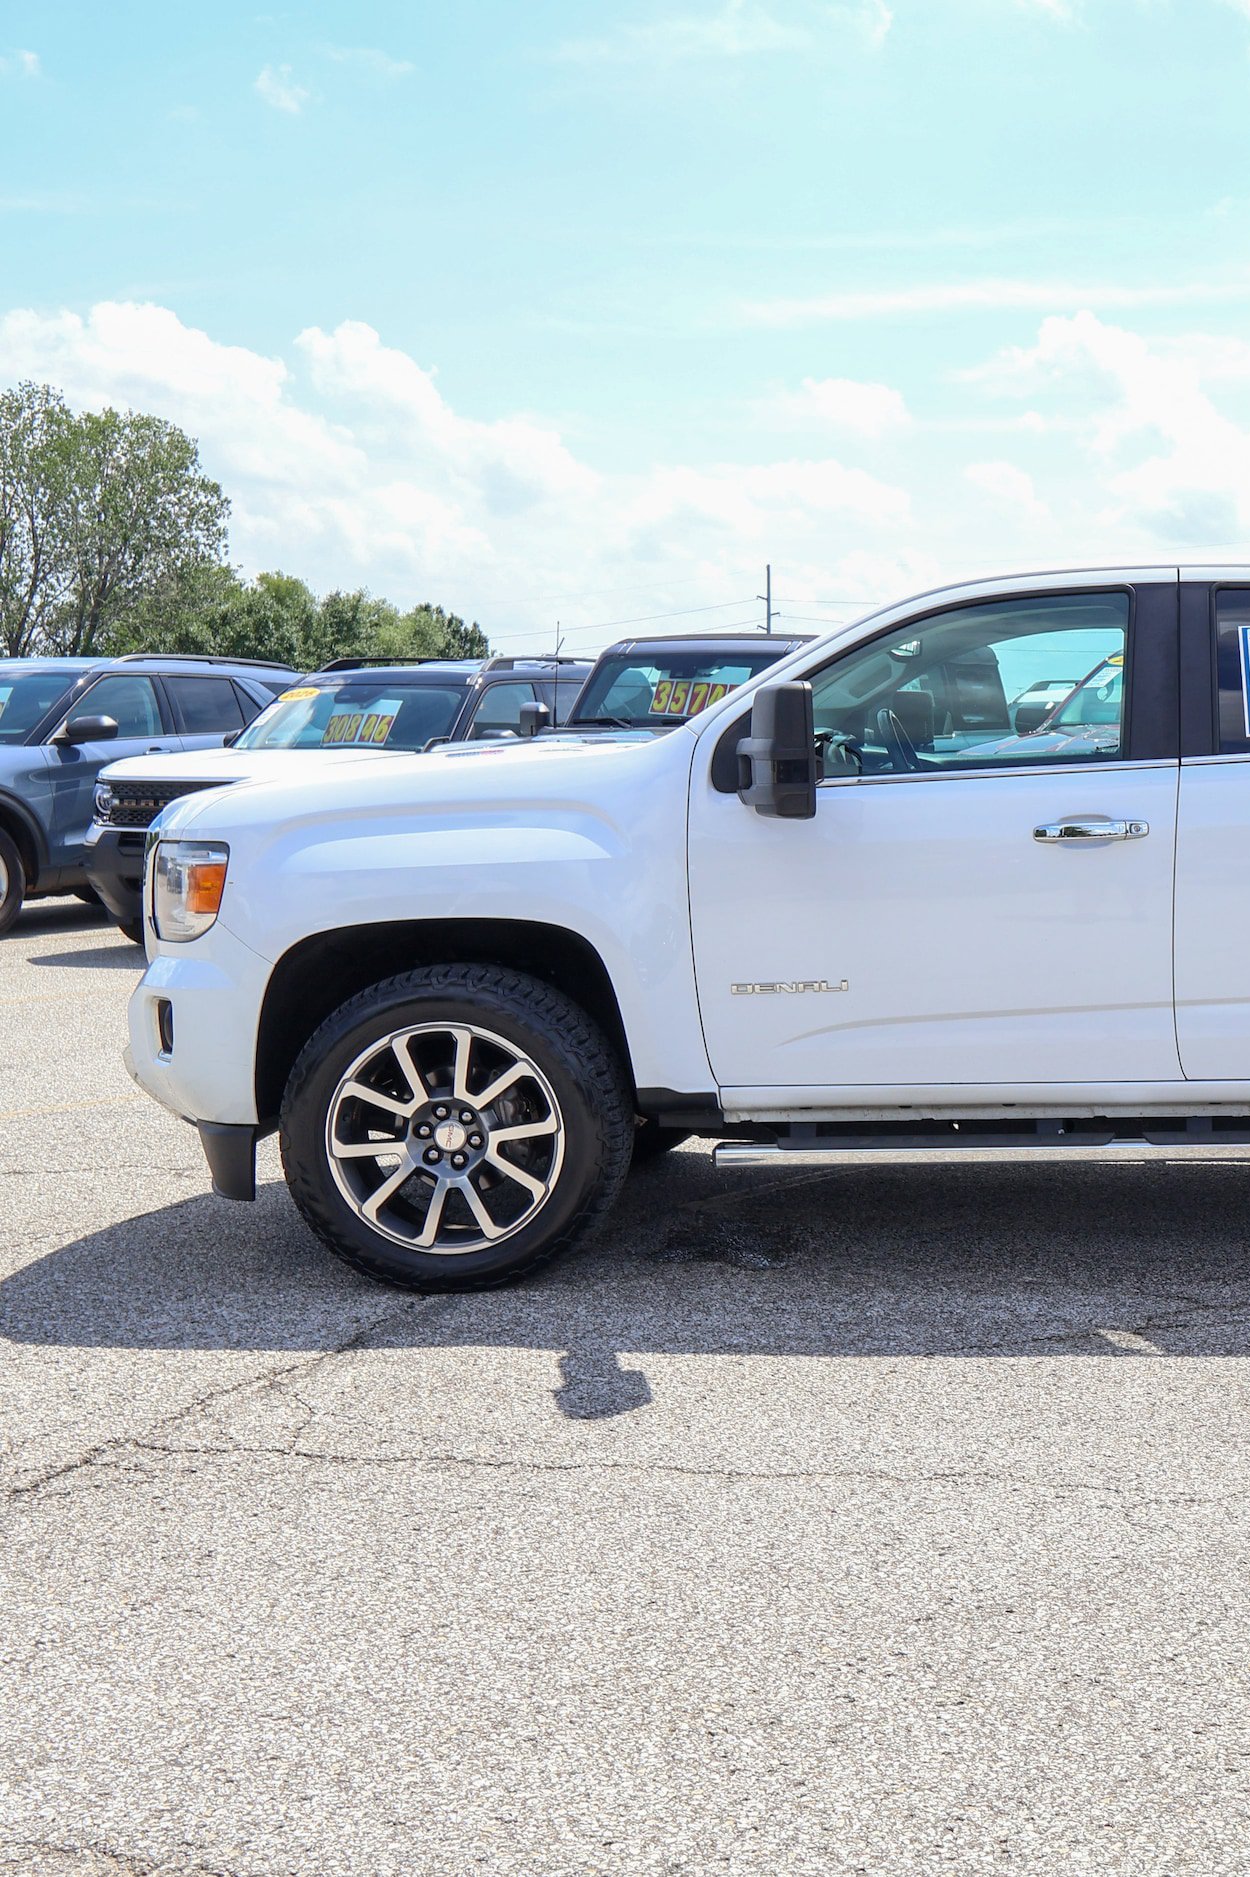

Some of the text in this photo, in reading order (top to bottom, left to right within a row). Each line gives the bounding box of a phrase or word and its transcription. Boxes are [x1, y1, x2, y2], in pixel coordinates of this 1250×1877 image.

[652, 681, 739, 713] 3570
[323, 714, 393, 744] 30846
[730, 979, 849, 995] DENALI
